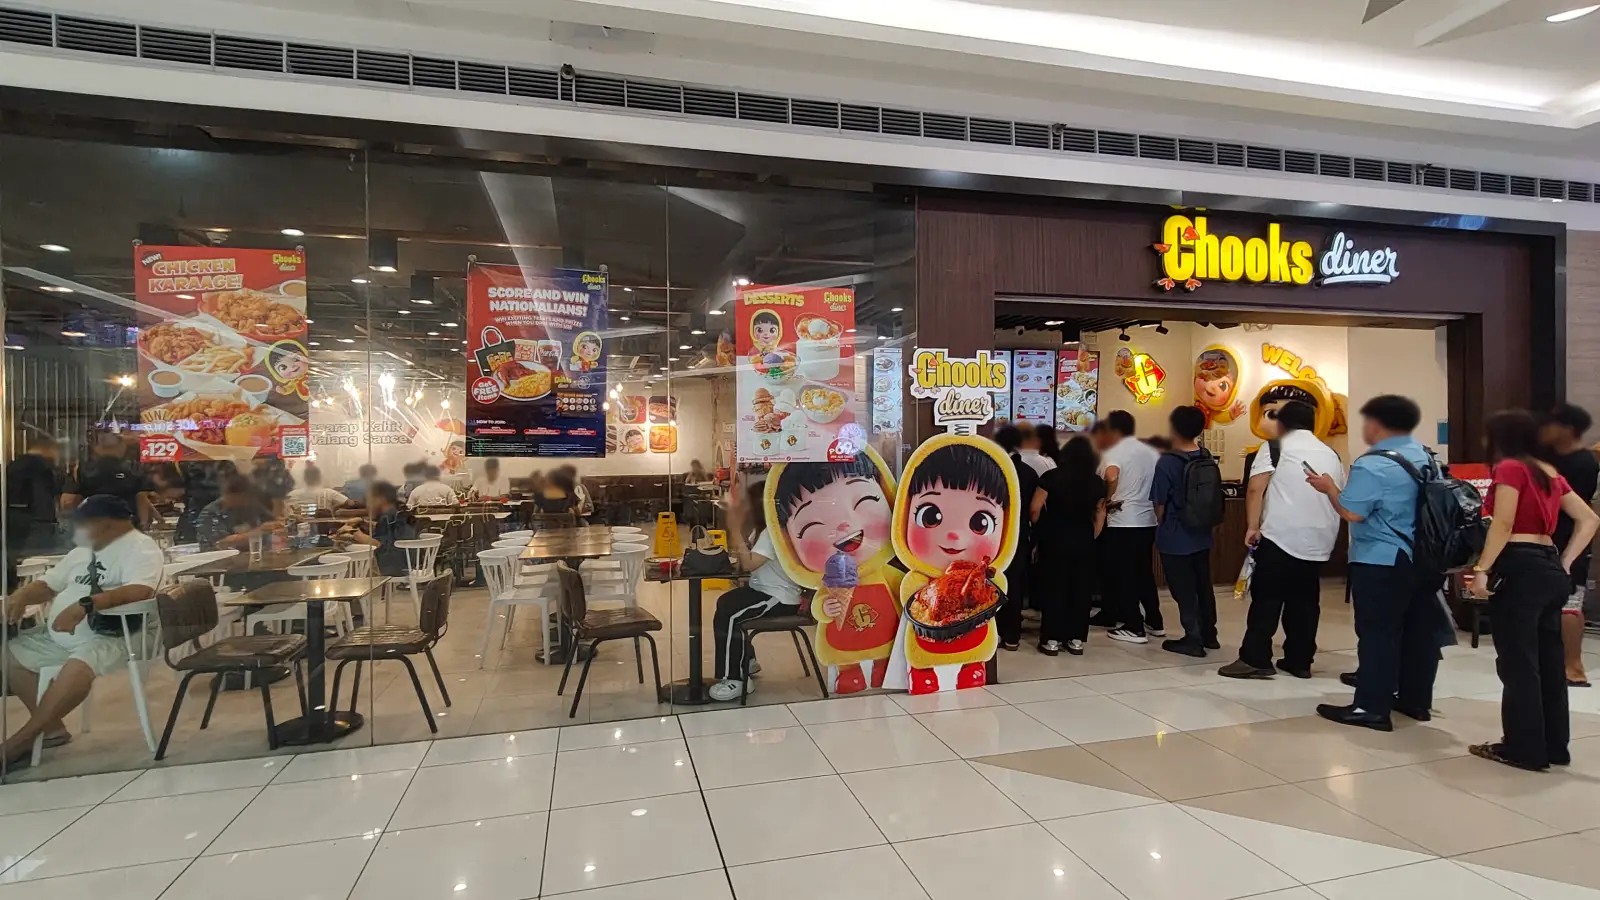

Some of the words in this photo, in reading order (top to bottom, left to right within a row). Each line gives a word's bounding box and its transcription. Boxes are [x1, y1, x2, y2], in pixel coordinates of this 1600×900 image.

[1163, 215, 1313, 285] Chooks
[1320, 232, 1400, 285] diner
[152, 258, 236, 276] CHICKEN
[148, 274, 244, 293] KARAAGE!
[488, 287, 532, 299] SCORE
[532, 289, 562, 301] AND
[562, 291, 589, 304] WIN
[743, 292, 805, 307] DESSERTS
[823, 291, 852, 304] Chooks
[489, 301, 588, 317] NATIONALIANS!
[917, 351, 1006, 389] Chooks
[1261, 343, 1328, 381] WELC
[473, 385, 498, 395] FREE
[938, 389, 989, 415] diner
[311, 423, 359, 434] asarap
